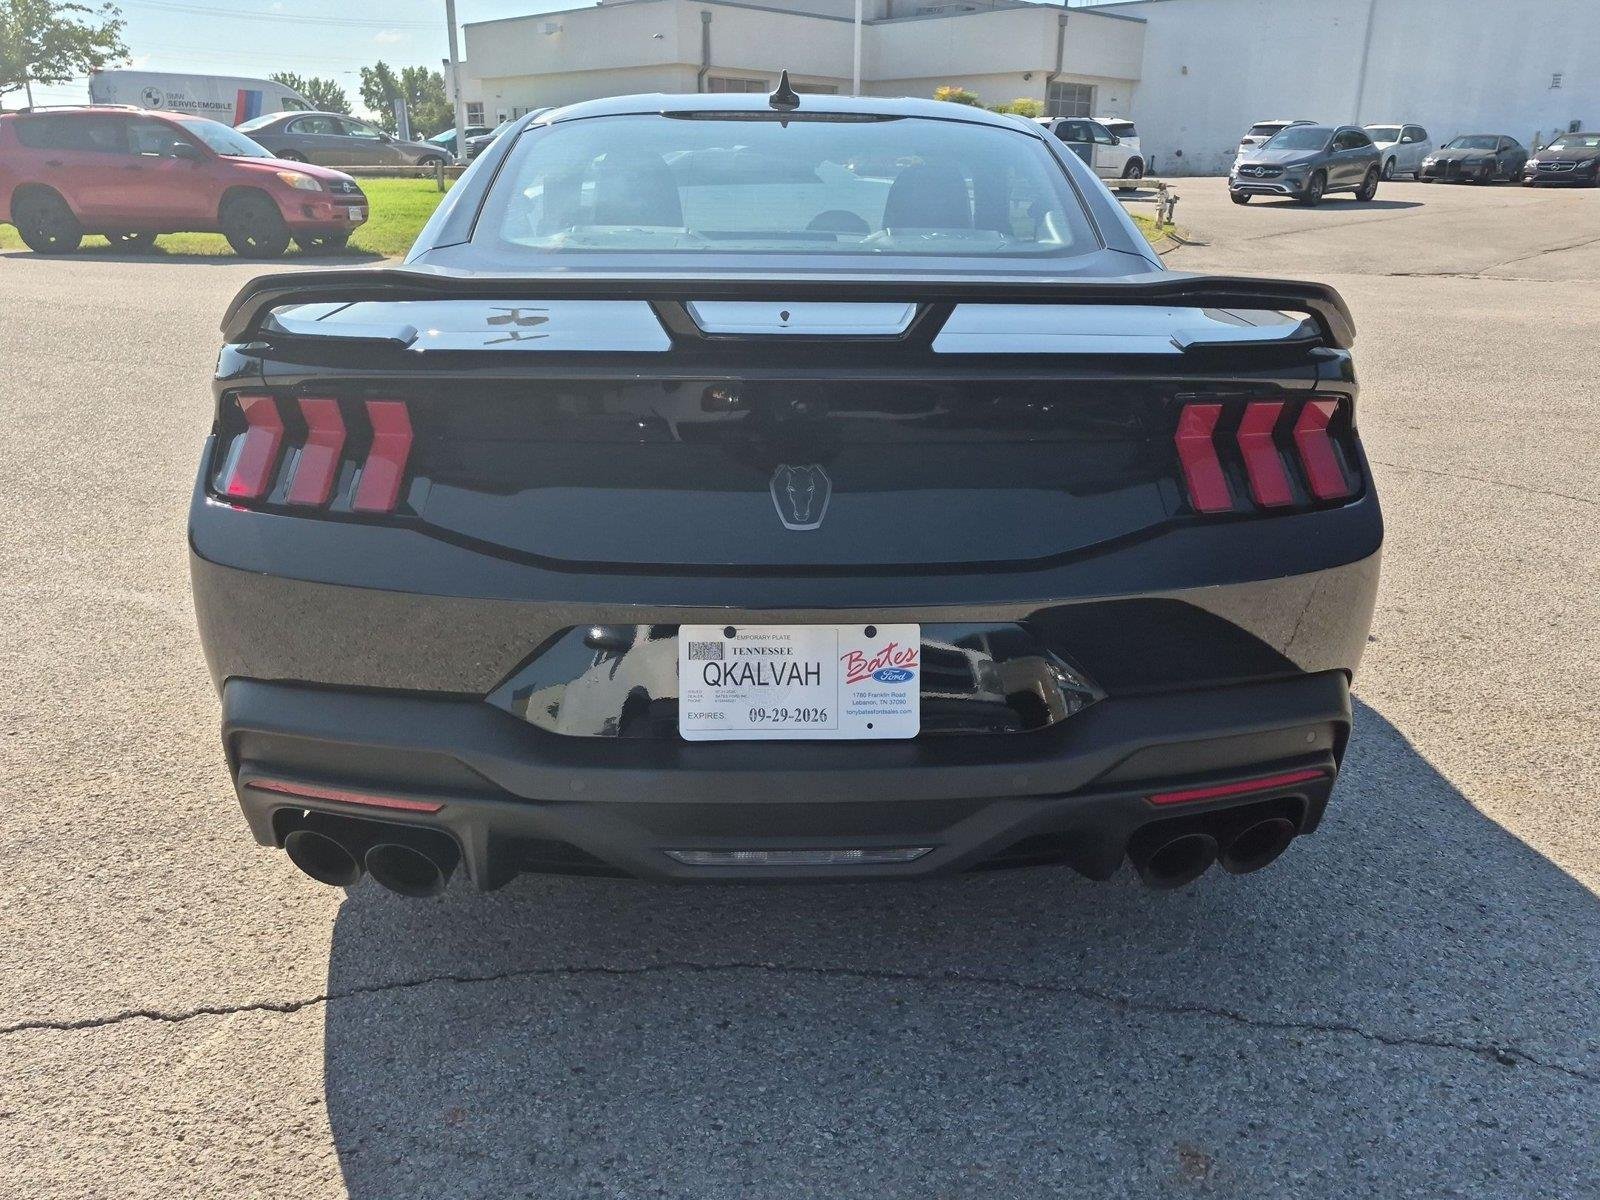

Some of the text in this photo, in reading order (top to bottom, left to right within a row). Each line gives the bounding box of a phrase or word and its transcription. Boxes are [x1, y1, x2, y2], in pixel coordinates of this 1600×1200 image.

[167, 100, 233, 110] SERVICEMOBILE
[732, 647, 794, 655] TENNESSEE
[840, 642, 919, 679] Bates
[703, 662, 820, 687] QKALVAH
[880, 669, 906, 681] Ford
[749, 707, 828, 723] 09-29-2026
